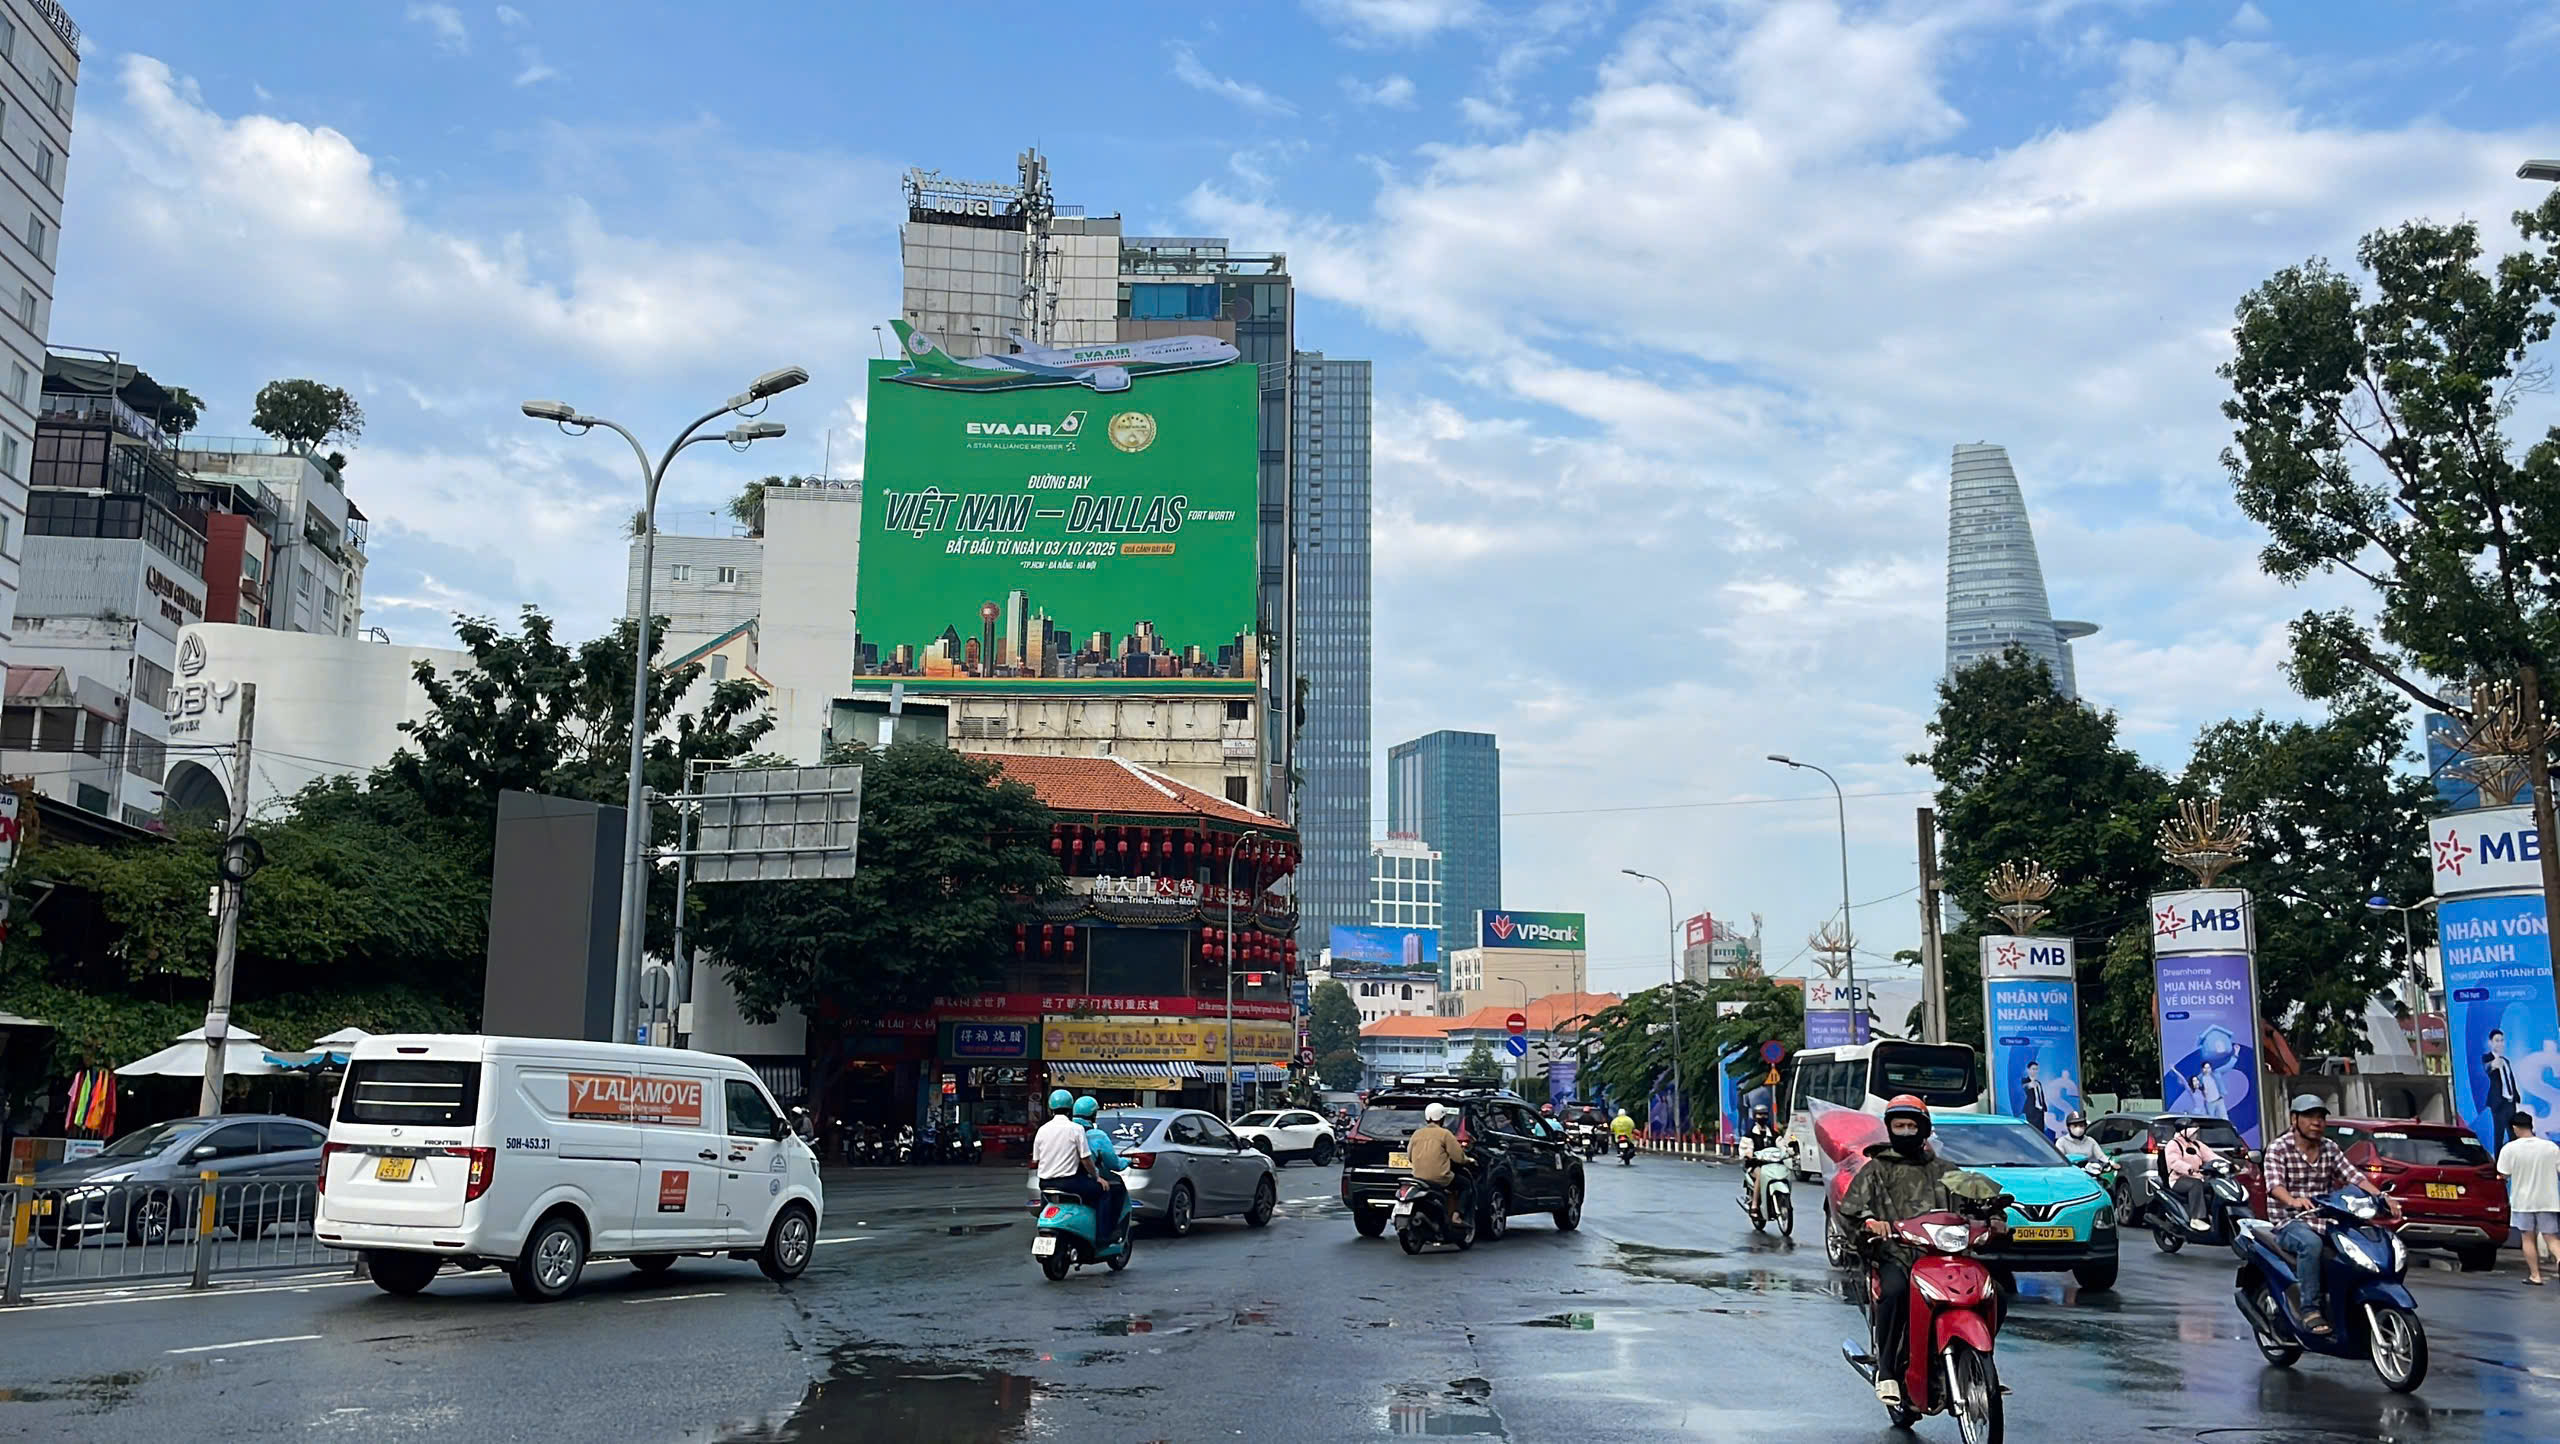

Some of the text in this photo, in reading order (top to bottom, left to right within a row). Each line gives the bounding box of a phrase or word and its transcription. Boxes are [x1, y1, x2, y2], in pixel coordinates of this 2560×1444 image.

[936, 195, 996, 217] hotel
[1027, 473, 1092, 490] ĐƯỜNG BAY
[955, 494, 1034, 532] NAM
[1065, 495, 1188, 534] DALLAS
[1187, 511, 1207, 521] FORT
[1208, 511, 1236, 521] WORTH
[945, 535, 1117, 557] BẮT ĐẦU TỪ NGÀY 03/10/2025
[2480, 830, 2542, 865] MB
[2192, 909, 2240, 932] MB
[2445, 912, 2549, 943] NHẬN VỐN
[1517, 923, 1578, 941] VPBank
[2030, 947, 2066, 966] MB
[2448, 944, 2516, 966] NHANH
[2162, 968, 2212, 977] Dreamhome
[1835, 987, 1862, 1000] MB
[2164, 981, 2187, 992] MUA
[2188, 979, 2213, 991] NHÀ
[1996, 988, 2068, 1007] NHẬN VỐN
[1997, 1008, 2049, 1021] NHANH
[1303, 1053, 1311, 1061] K
[593, 1079, 700, 1106] LALAMOVE
[506, 1137, 551, 1150] 50H-453.31
